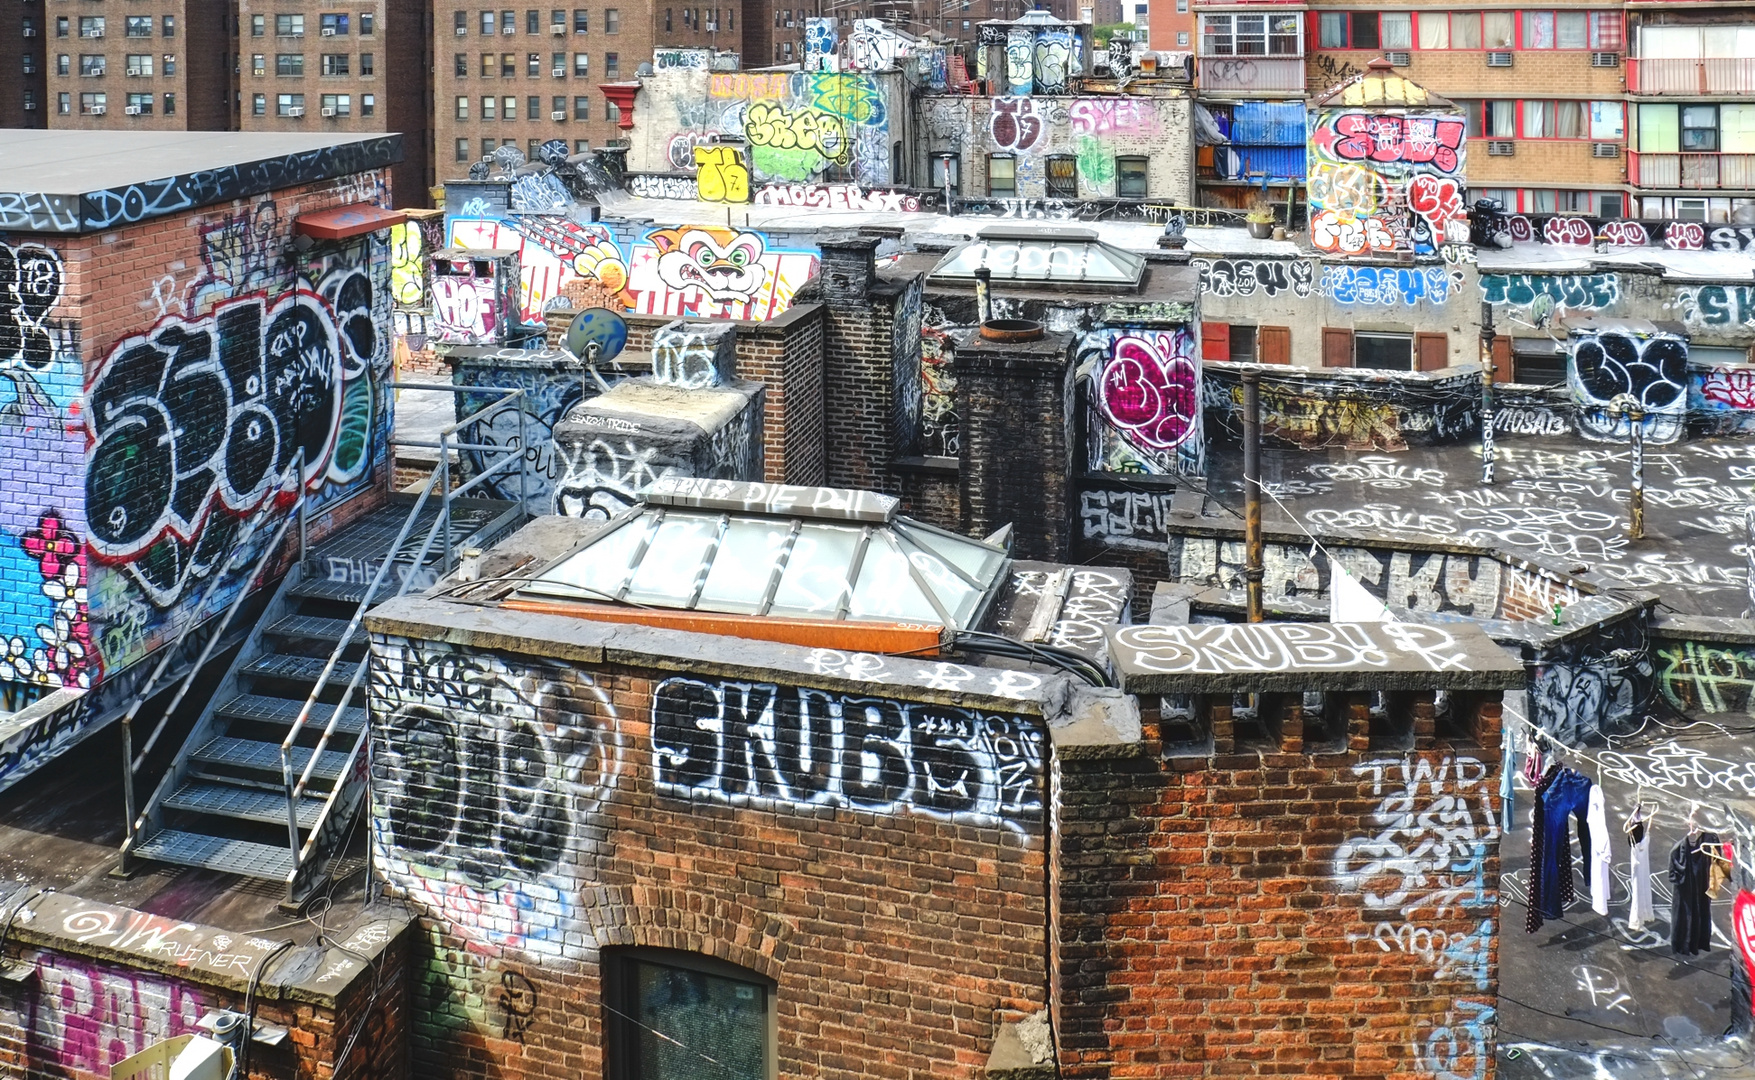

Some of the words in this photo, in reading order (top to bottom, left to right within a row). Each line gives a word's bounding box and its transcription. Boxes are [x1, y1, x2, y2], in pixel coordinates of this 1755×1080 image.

[709, 73, 788, 99] MOSA
[84, 176, 192, 229] DOZ
[461, 197, 493, 217] MSK
[1306, 463, 1449, 488] BONUS
[743, 482, 800, 508] DIE
[1305, 508, 1458, 534] BONUS
[156, 938, 254, 977] RUINER
